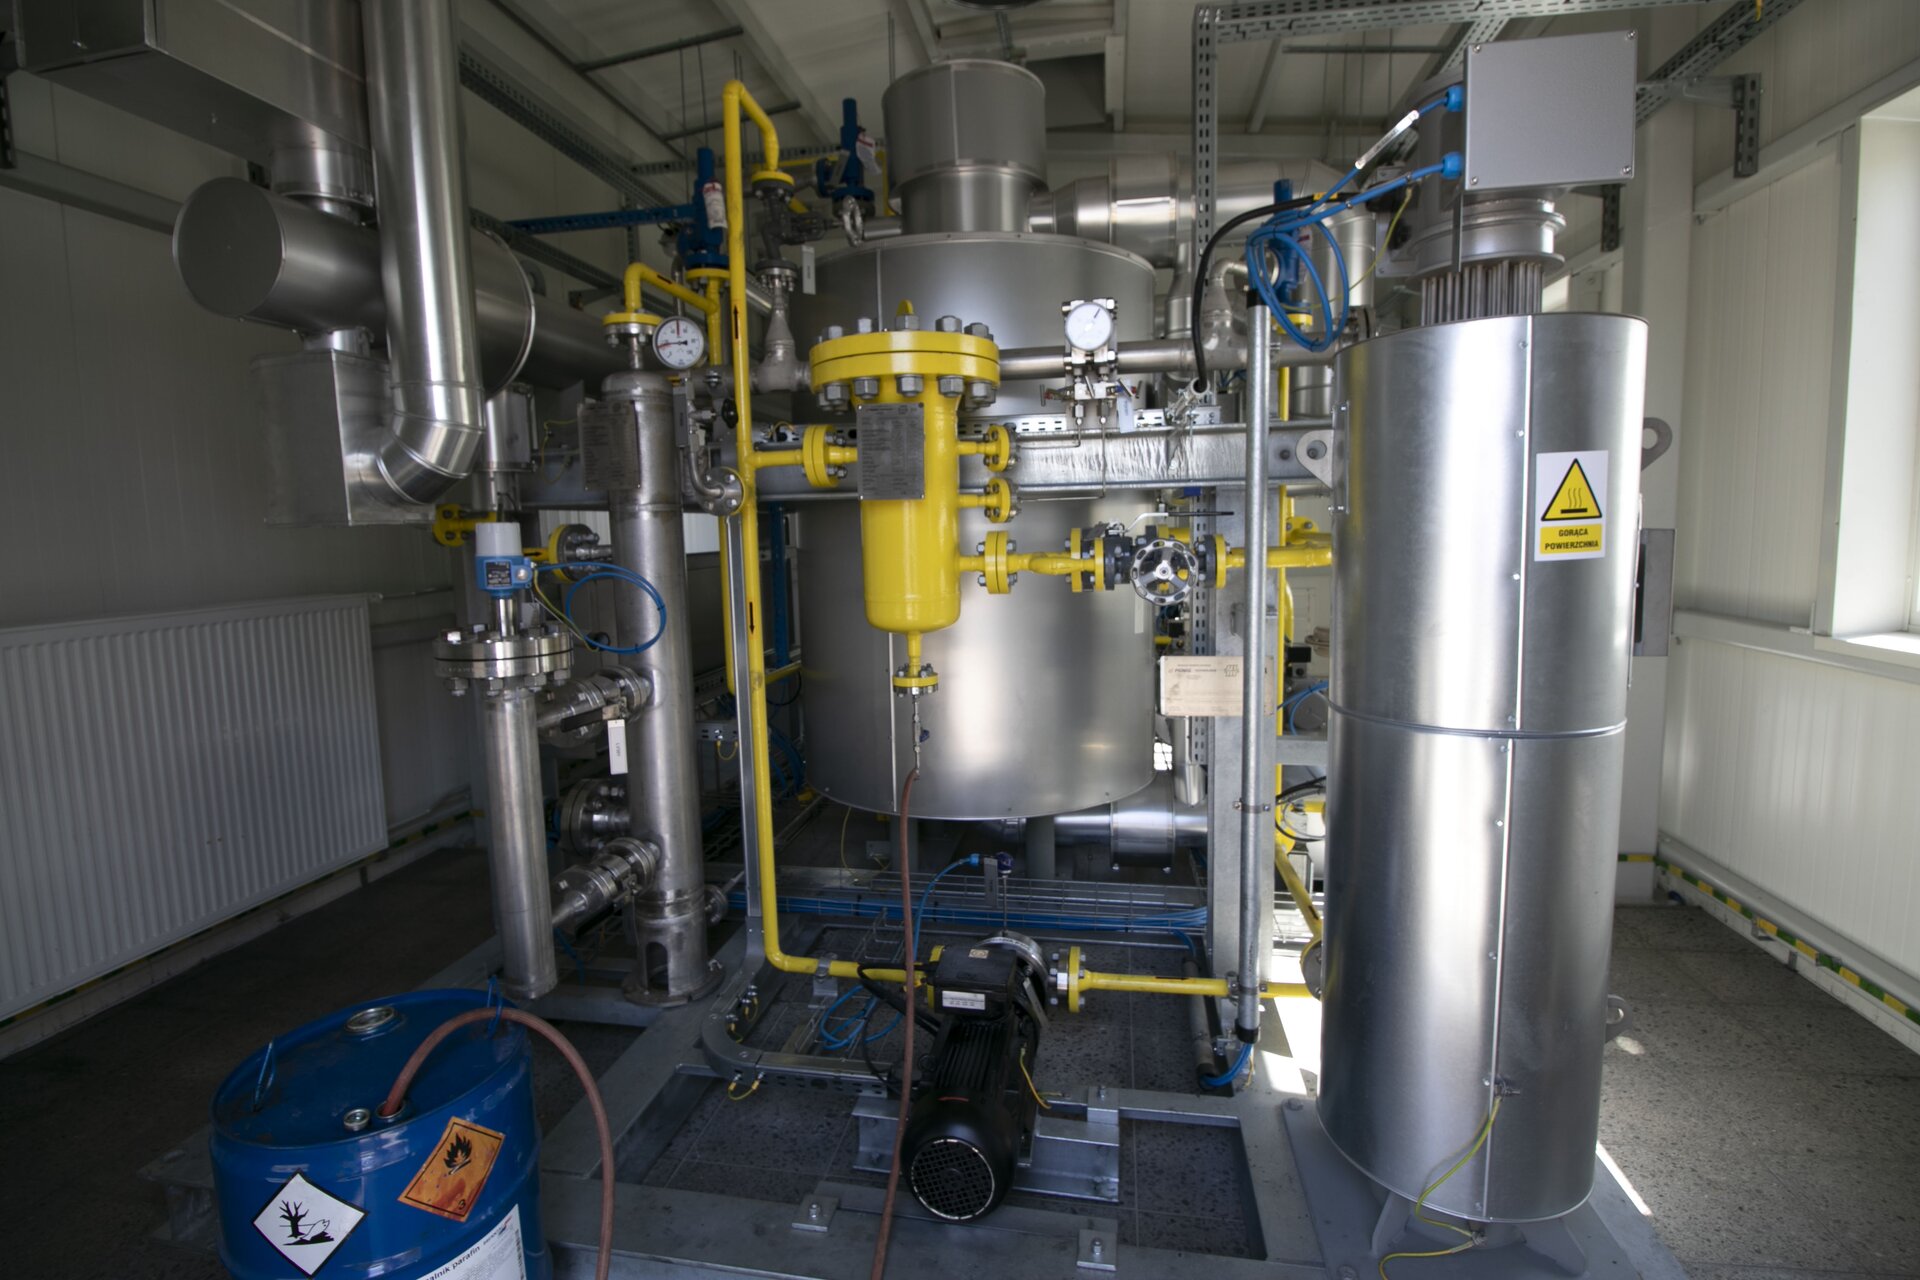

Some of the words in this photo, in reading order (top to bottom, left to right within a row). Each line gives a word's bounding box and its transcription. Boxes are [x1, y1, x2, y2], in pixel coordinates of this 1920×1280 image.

[1559, 528, 1588, 537] GORĄCA
[1545, 540, 1598, 550] POWIERZCHNIA
[452, 1246, 480, 1270] parafin
